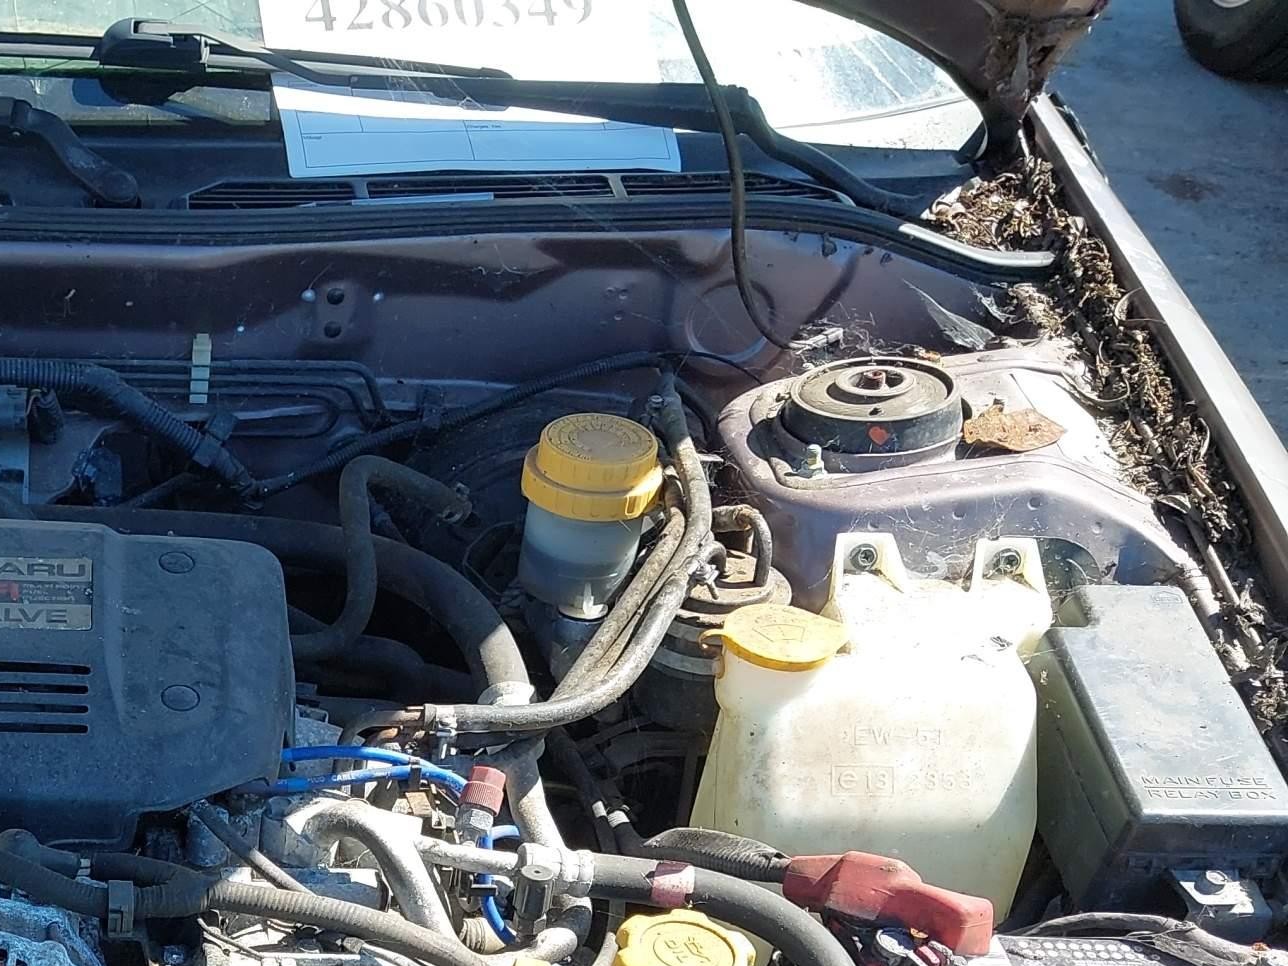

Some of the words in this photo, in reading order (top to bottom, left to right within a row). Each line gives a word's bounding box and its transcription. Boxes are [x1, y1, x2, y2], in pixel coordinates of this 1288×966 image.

[1141, 775, 1201, 786] MAIN
[1205, 776, 1267, 787] FUSE
[1147, 788, 1219, 799] RELAY
[1228, 790, 1278, 801] BOX
